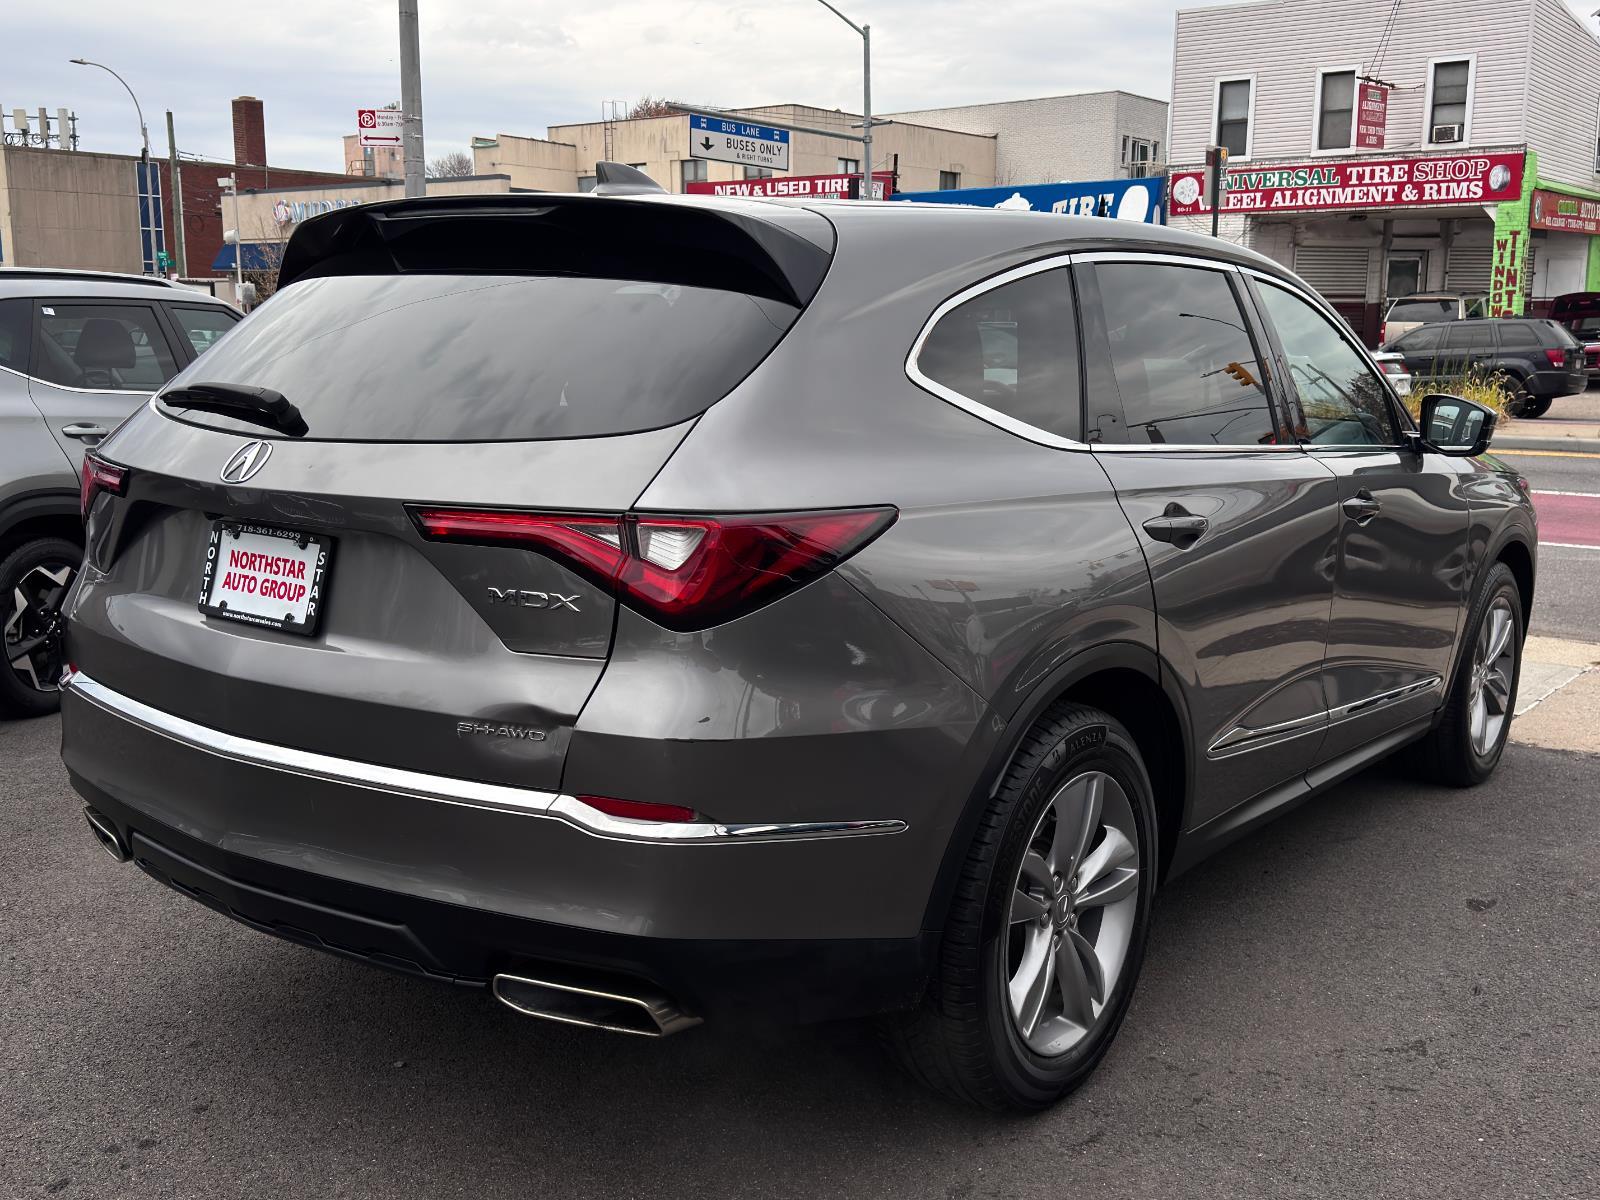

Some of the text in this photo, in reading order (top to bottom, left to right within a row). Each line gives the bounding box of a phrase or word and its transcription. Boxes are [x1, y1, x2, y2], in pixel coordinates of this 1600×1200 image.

[721, 122, 760, 137] BUS LANE
[726, 137, 782, 157] BUSES ONLY
[714, 183, 751, 196] NEW
[752, 185, 764, 196] &
[766, 180, 811, 195] USED
[1202, 168, 1340, 192] NIVERSAL
[1347, 164, 1409, 185] TIRE
[1413, 159, 1490, 182] SHOP
[1052, 193, 1115, 218] TIRE
[1198, 181, 1484, 211] WEEL ALIGNMENT & RIMS
[1580, 201, 1596, 219] AUTO
[1491, 239, 1508, 317] WINDOW
[238, 524, 301, 540] 718-361-6299
[199, 531, 219, 604] NORTH
[229, 549, 306, 580] NORTHSTAR
[222, 571, 306, 602] AUTO GROUP
[307, 551, 326, 616] STAR
[487, 587, 581, 613] MDX
[456, 722, 545, 741] SH-AWD
